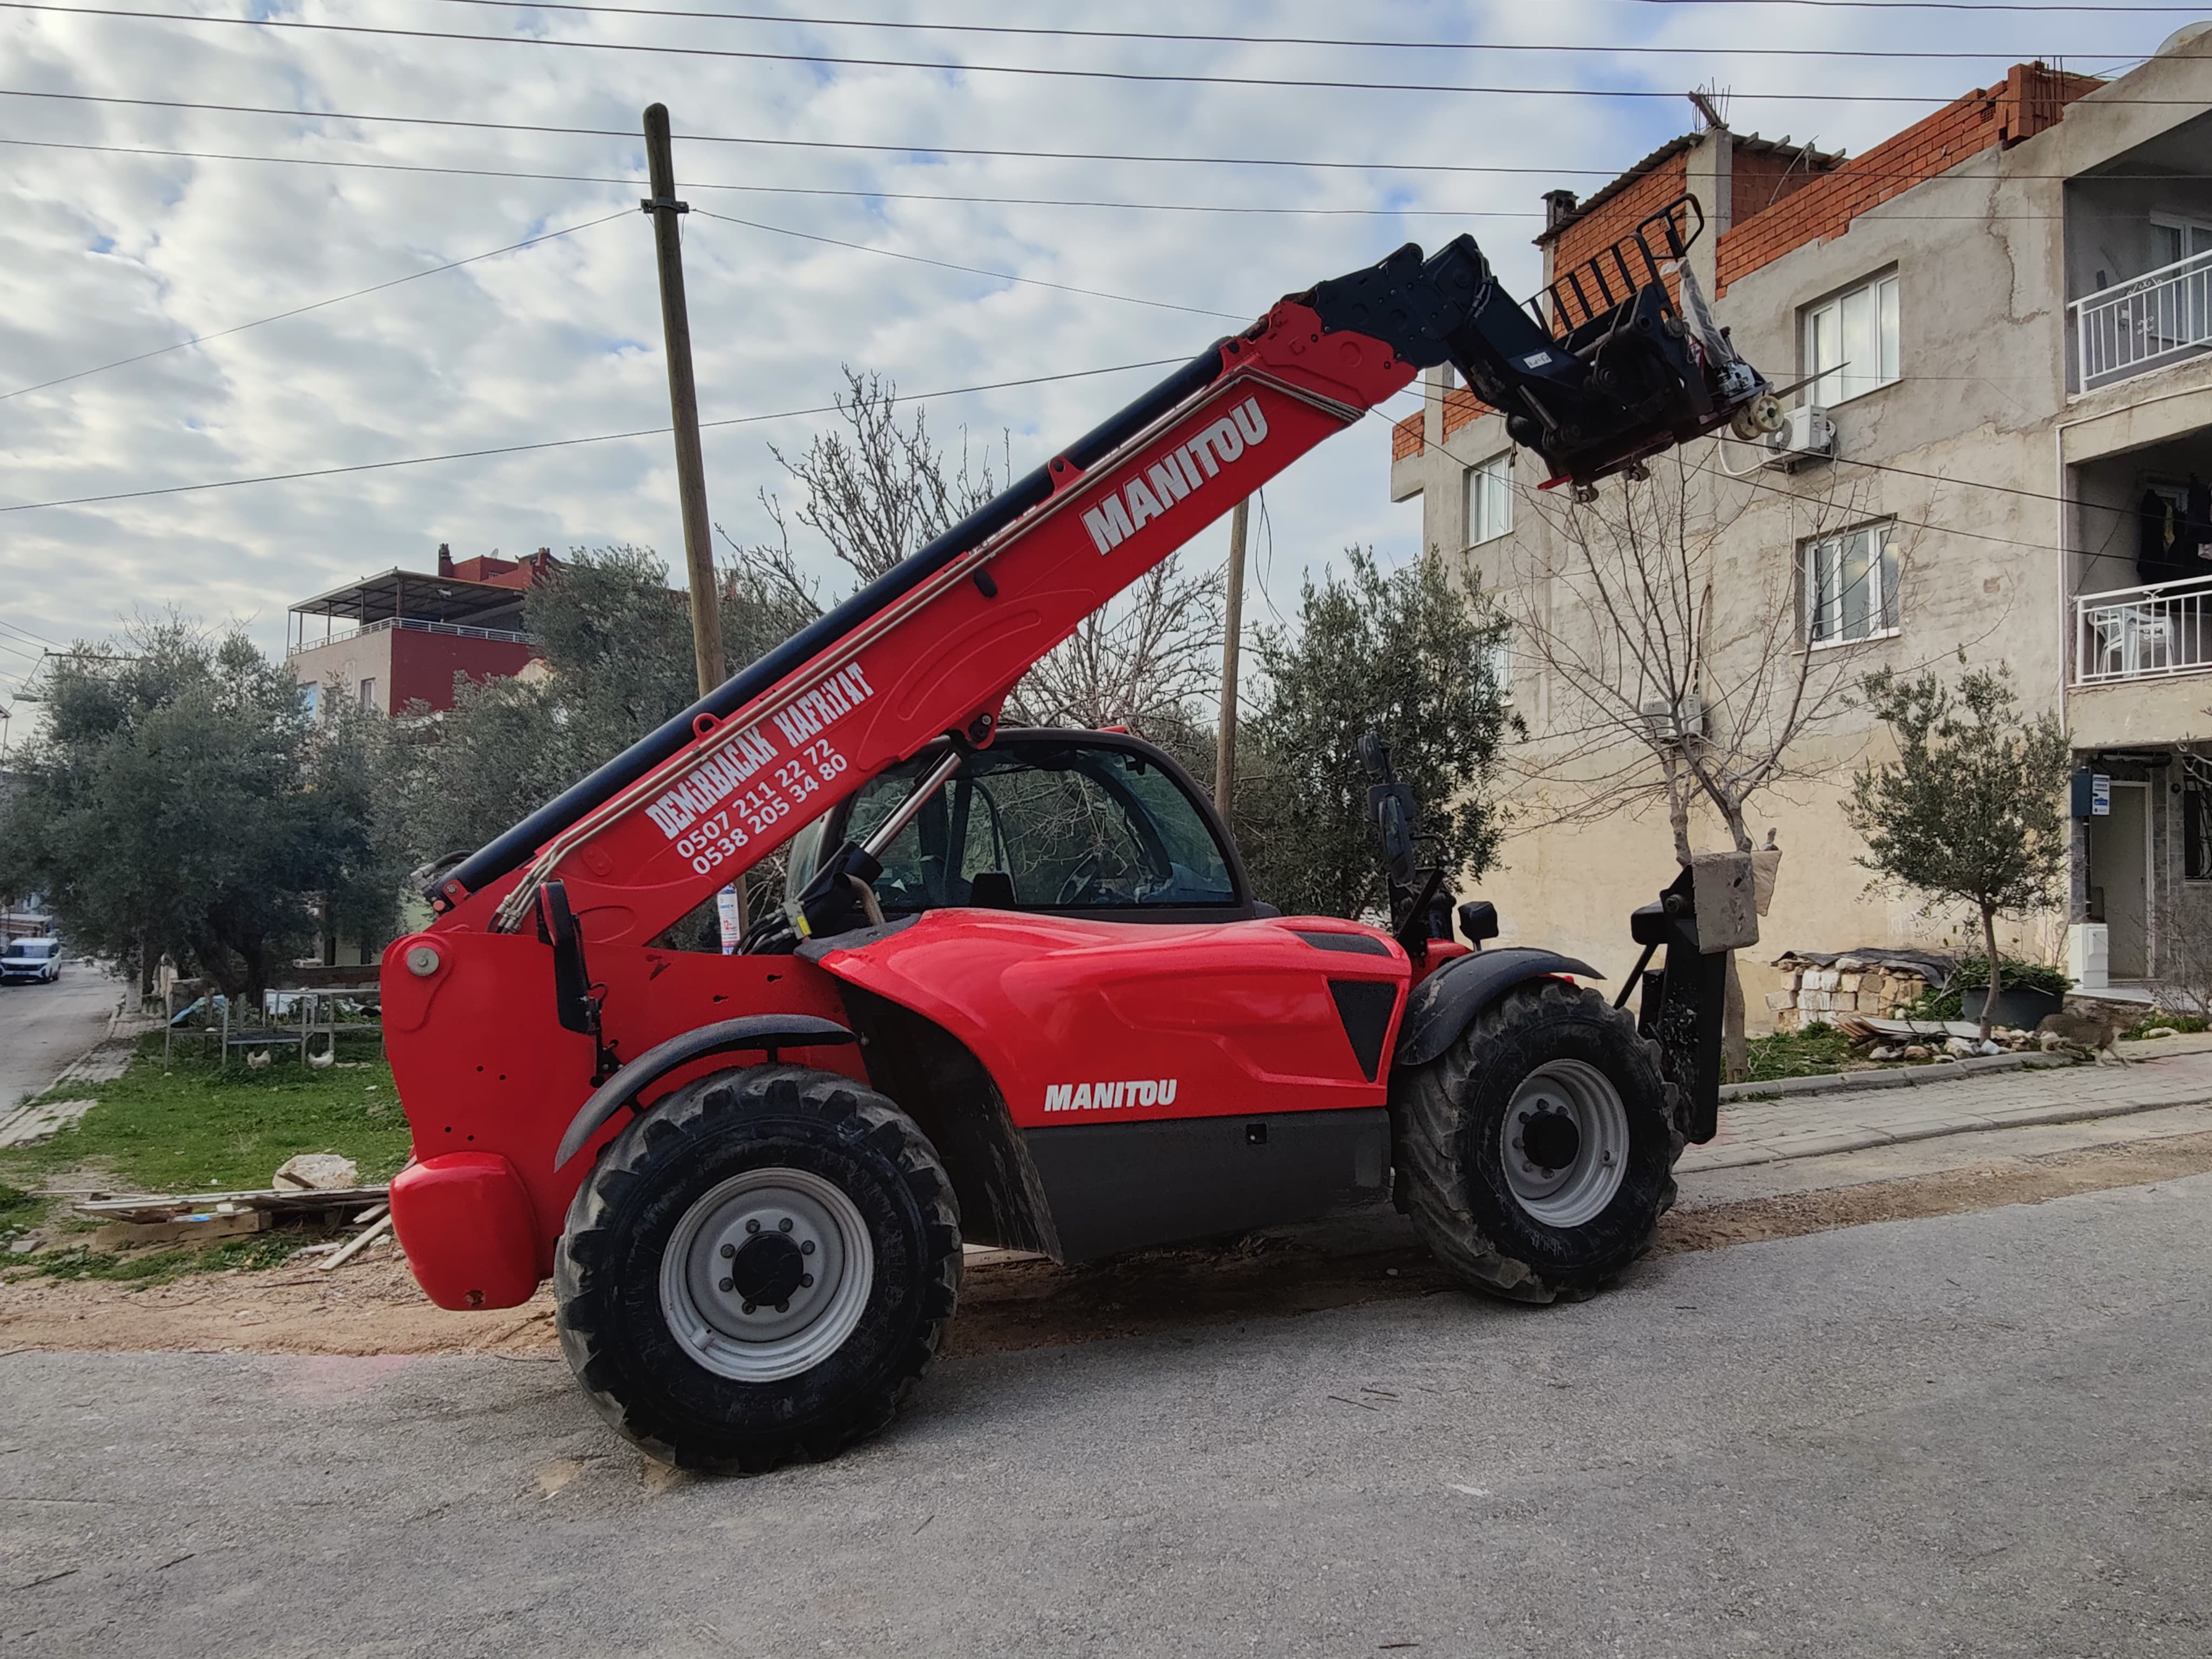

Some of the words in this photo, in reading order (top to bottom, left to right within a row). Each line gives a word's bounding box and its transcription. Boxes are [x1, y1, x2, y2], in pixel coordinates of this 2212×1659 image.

[1083, 397, 1267, 555] MANITOU
[677, 811, 729, 858] 0507
[732, 782, 777, 818] 211
[774, 760, 806, 787] 22
[802, 739, 835, 765] 72
[692, 828, 748, 874] 0538
[747, 797, 790, 834] 205
[789, 775, 819, 803] 34
[818, 754, 847, 781] 80
[1044, 1079, 1177, 1111] MANITOU
